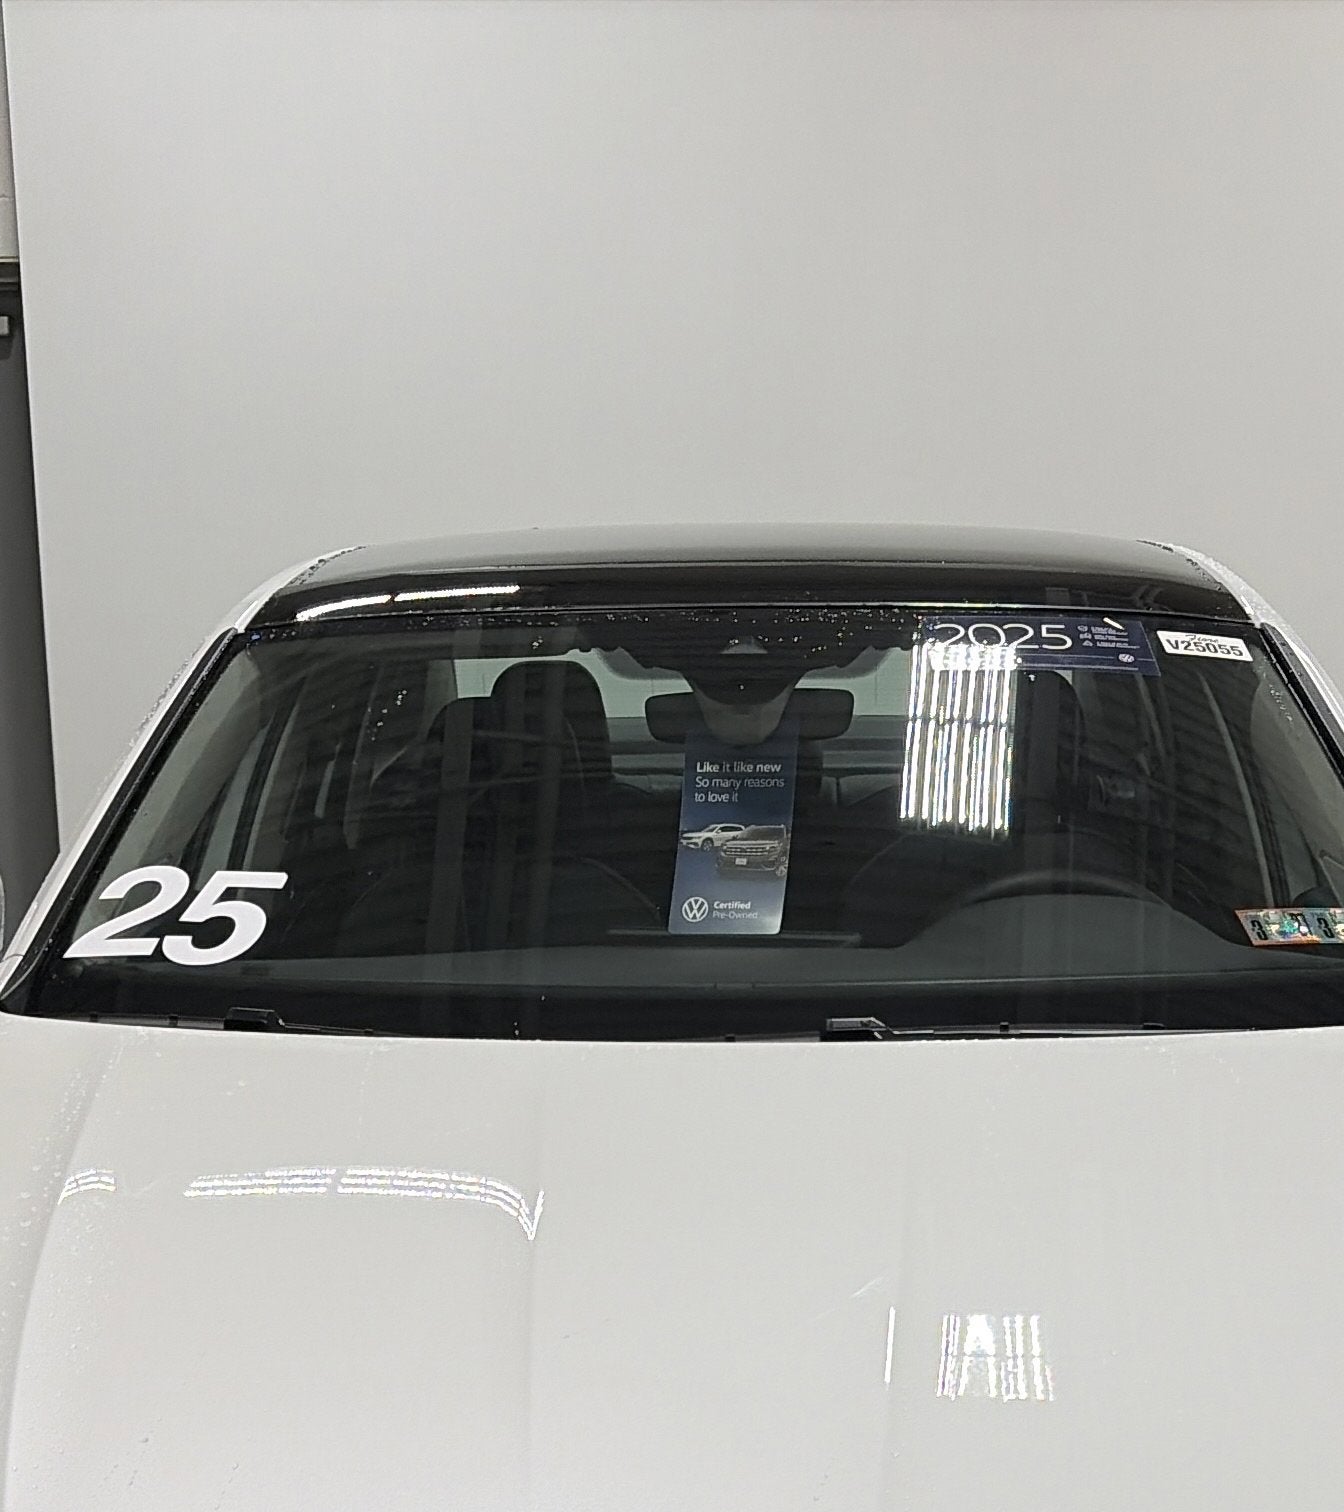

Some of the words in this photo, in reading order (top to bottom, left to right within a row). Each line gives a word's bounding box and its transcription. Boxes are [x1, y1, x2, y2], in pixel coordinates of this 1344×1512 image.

[933, 623, 1073, 650] 2025
[1165, 638, 1244, 657] V25055
[696, 761, 720, 773] Like
[722, 761, 731, 773] it
[733, 761, 754, 773] like
[756, 764, 782, 773] new
[695, 776, 710, 788] So
[711, 778, 741, 791] many
[744, 778, 785, 788] reasons
[694, 792, 706, 802] to
[707, 791, 729, 802] love
[731, 791, 739, 802] it
[713, 901, 752, 909] Certified
[62, 865, 289, 966] 25
[712, 911, 759, 919] Pre-Owned
[1250, 919, 1269, 941] 3
[1316, 917, 1335, 939] 3
